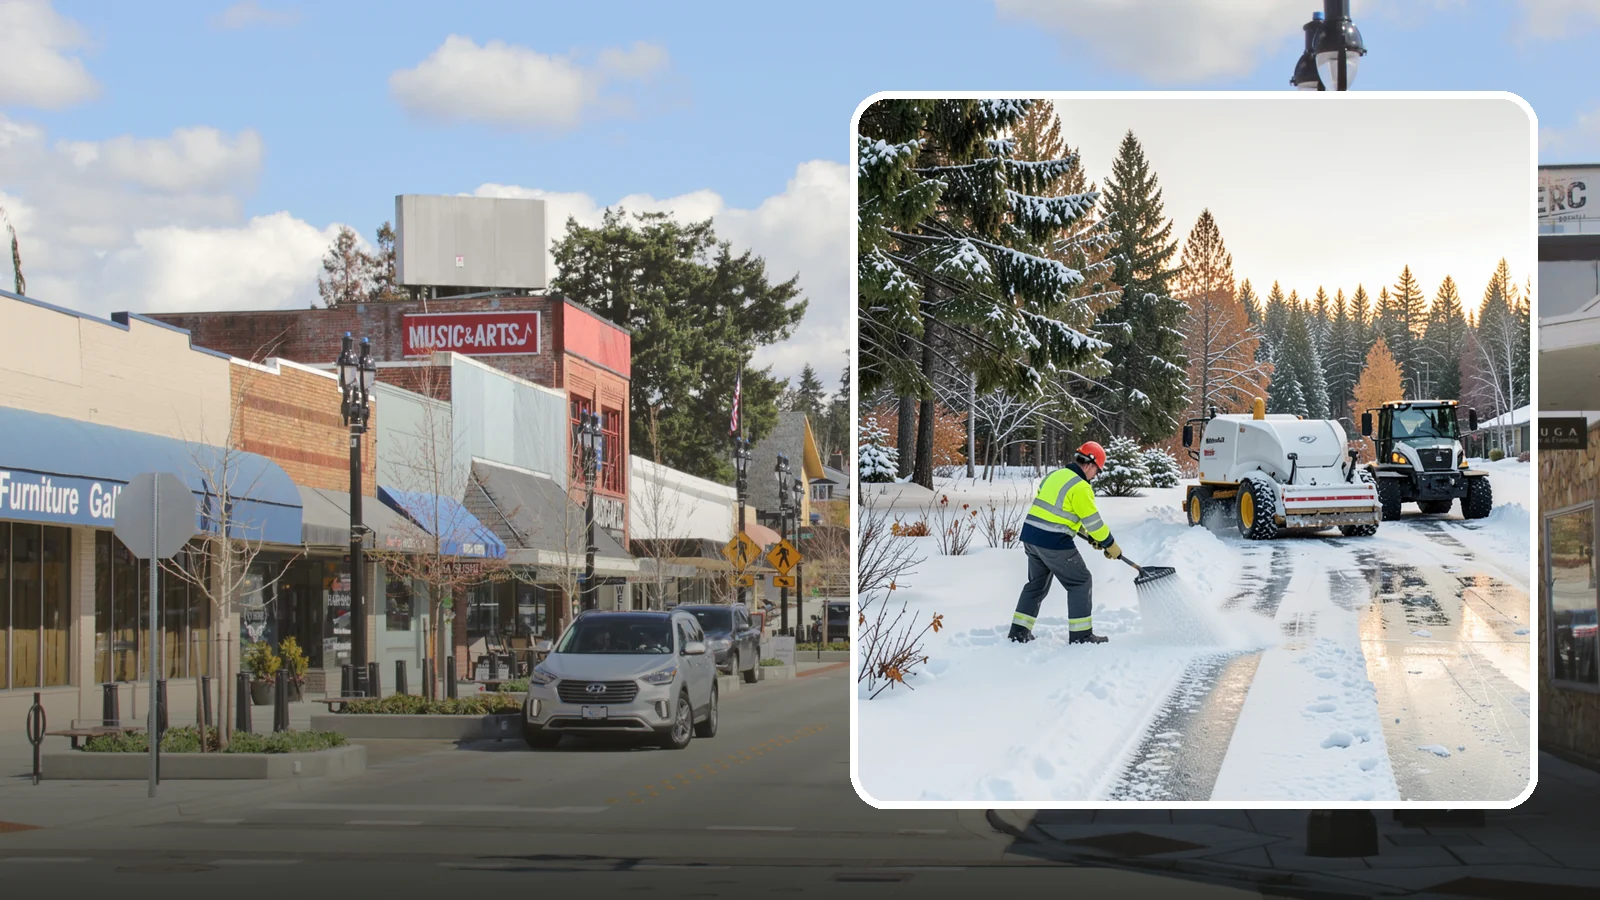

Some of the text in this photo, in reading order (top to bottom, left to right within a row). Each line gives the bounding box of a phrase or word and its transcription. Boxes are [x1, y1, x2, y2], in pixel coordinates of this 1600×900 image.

[0, 471, 122, 519] Furniture Gal
[453, 563, 479, 574] SUSHI
